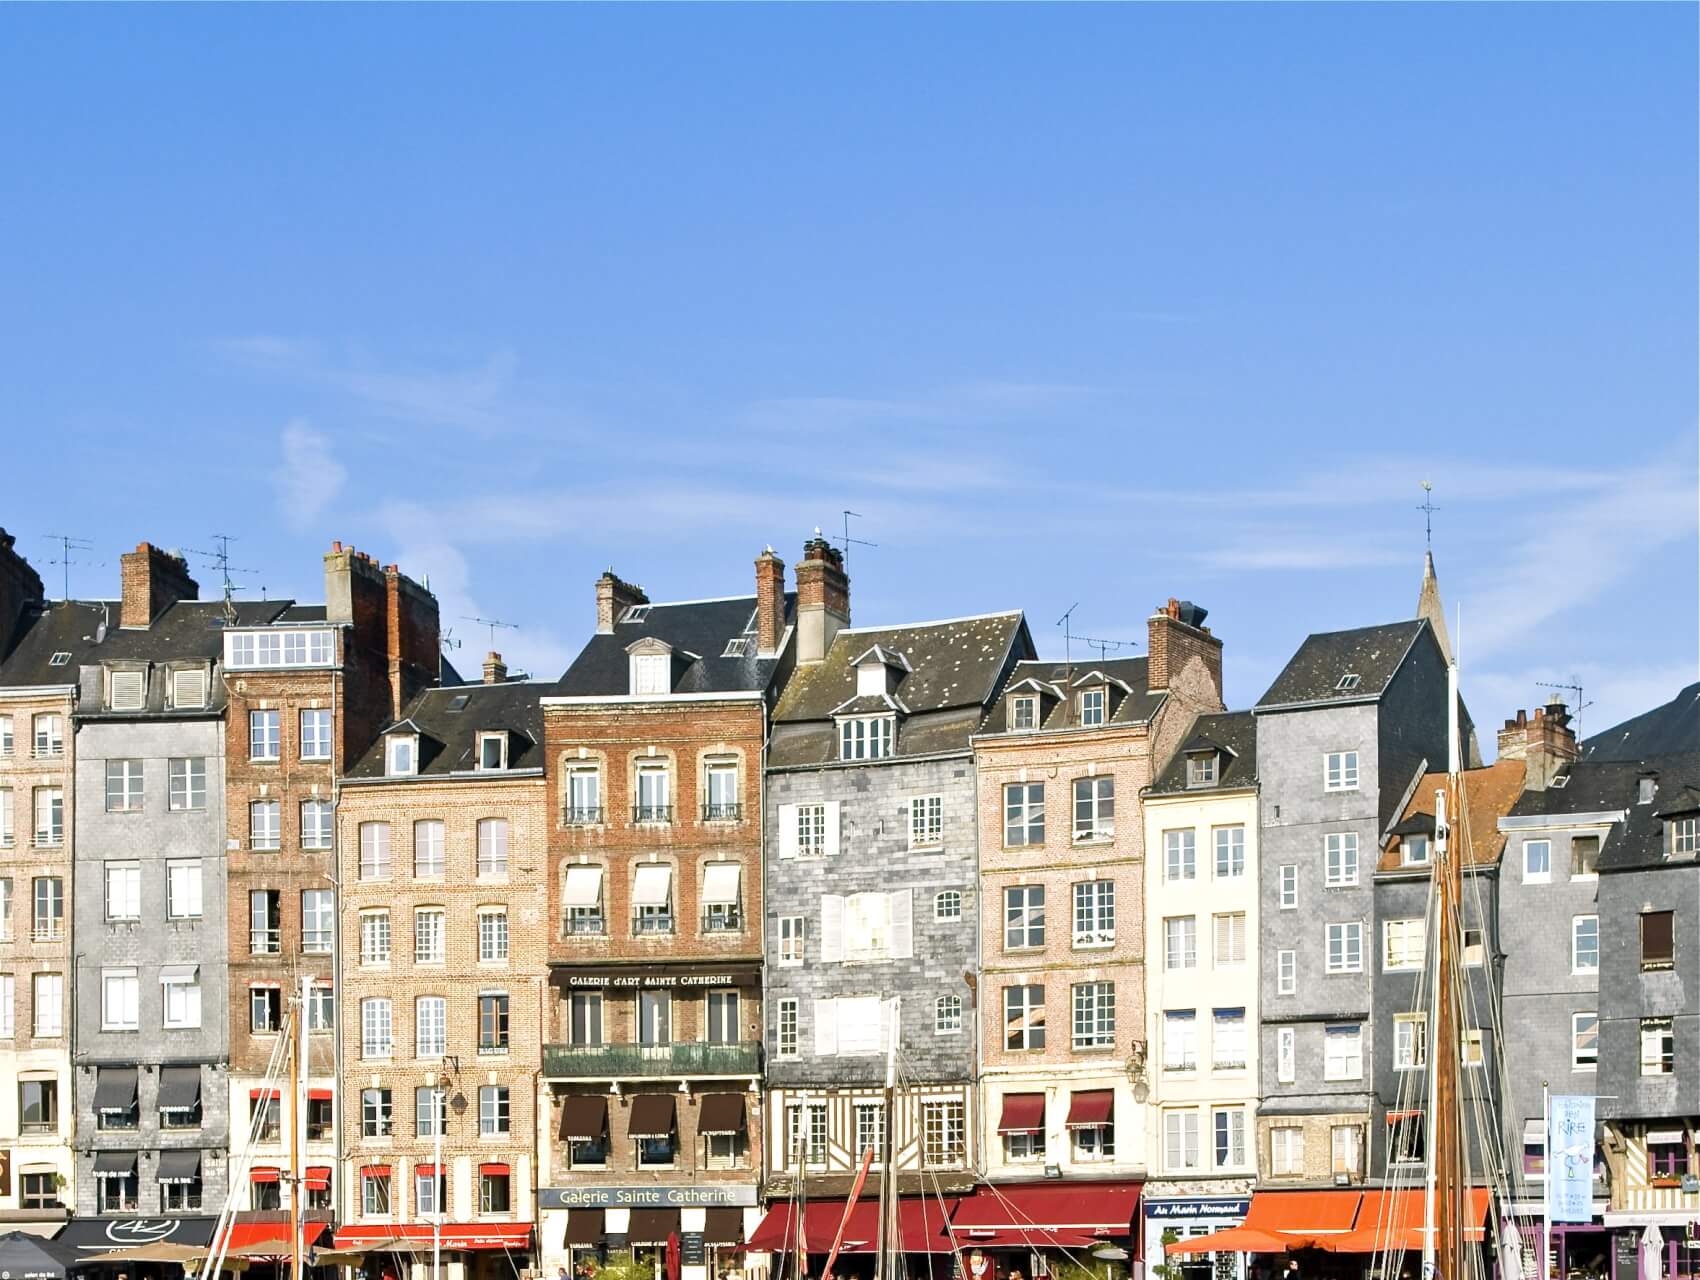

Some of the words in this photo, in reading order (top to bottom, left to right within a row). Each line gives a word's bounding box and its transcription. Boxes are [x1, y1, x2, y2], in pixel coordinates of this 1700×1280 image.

[570, 976, 610, 986] GALERIE
[614, 975, 640, 986] d'ART
[644, 976, 677, 986] SAINTE
[681, 975, 732, 986] CATHERINE
[560, 1190, 609, 1207] Galerie
[616, 1190, 660, 1203] Sainte
[667, 1189, 736, 1203] Catherine
[1154, 1205, 1168, 1215] Au
[1169, 1205, 1198, 1215] Marin
[1199, 1203, 1240, 1214] Normand
